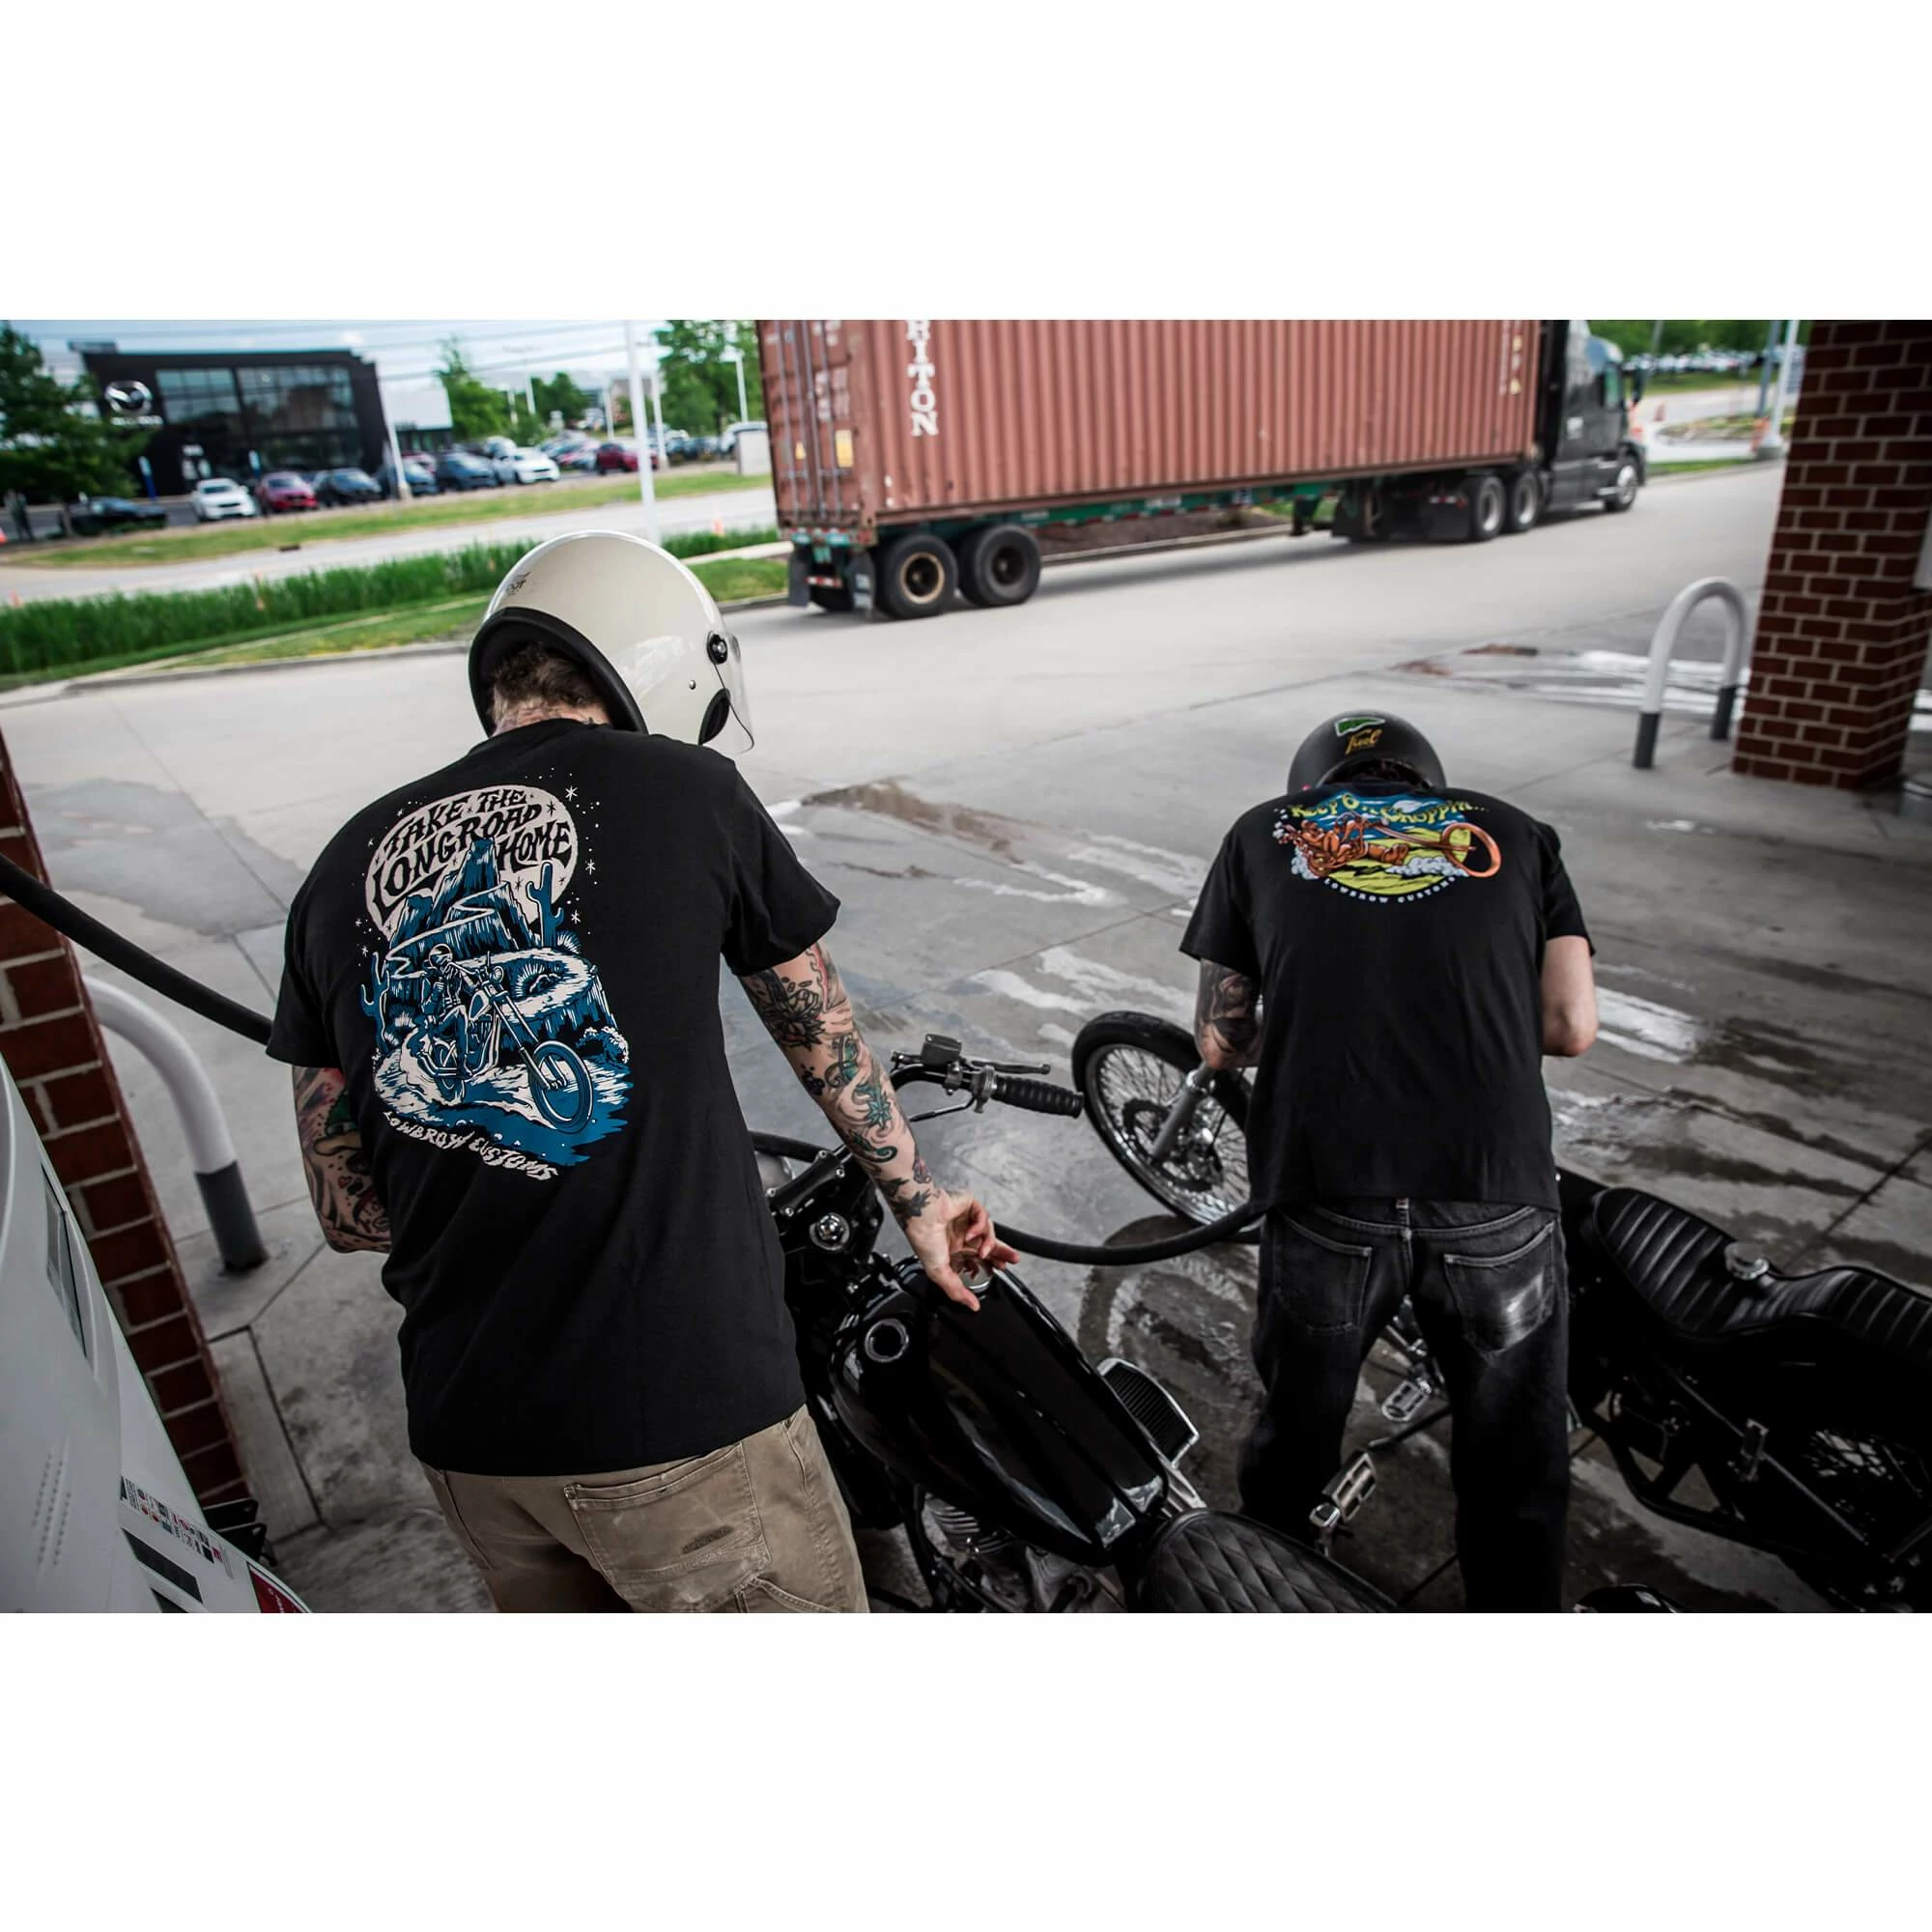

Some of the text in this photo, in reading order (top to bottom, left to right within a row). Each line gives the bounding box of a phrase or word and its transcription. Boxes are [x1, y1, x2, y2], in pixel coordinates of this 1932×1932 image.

[384, 788, 528, 858] TAKE THE
[496, 820, 573, 873] HOME
[372, 803, 543, 924] LONG ROAD
[384, 1111, 559, 1181] LOWBROW CUSTOMS
